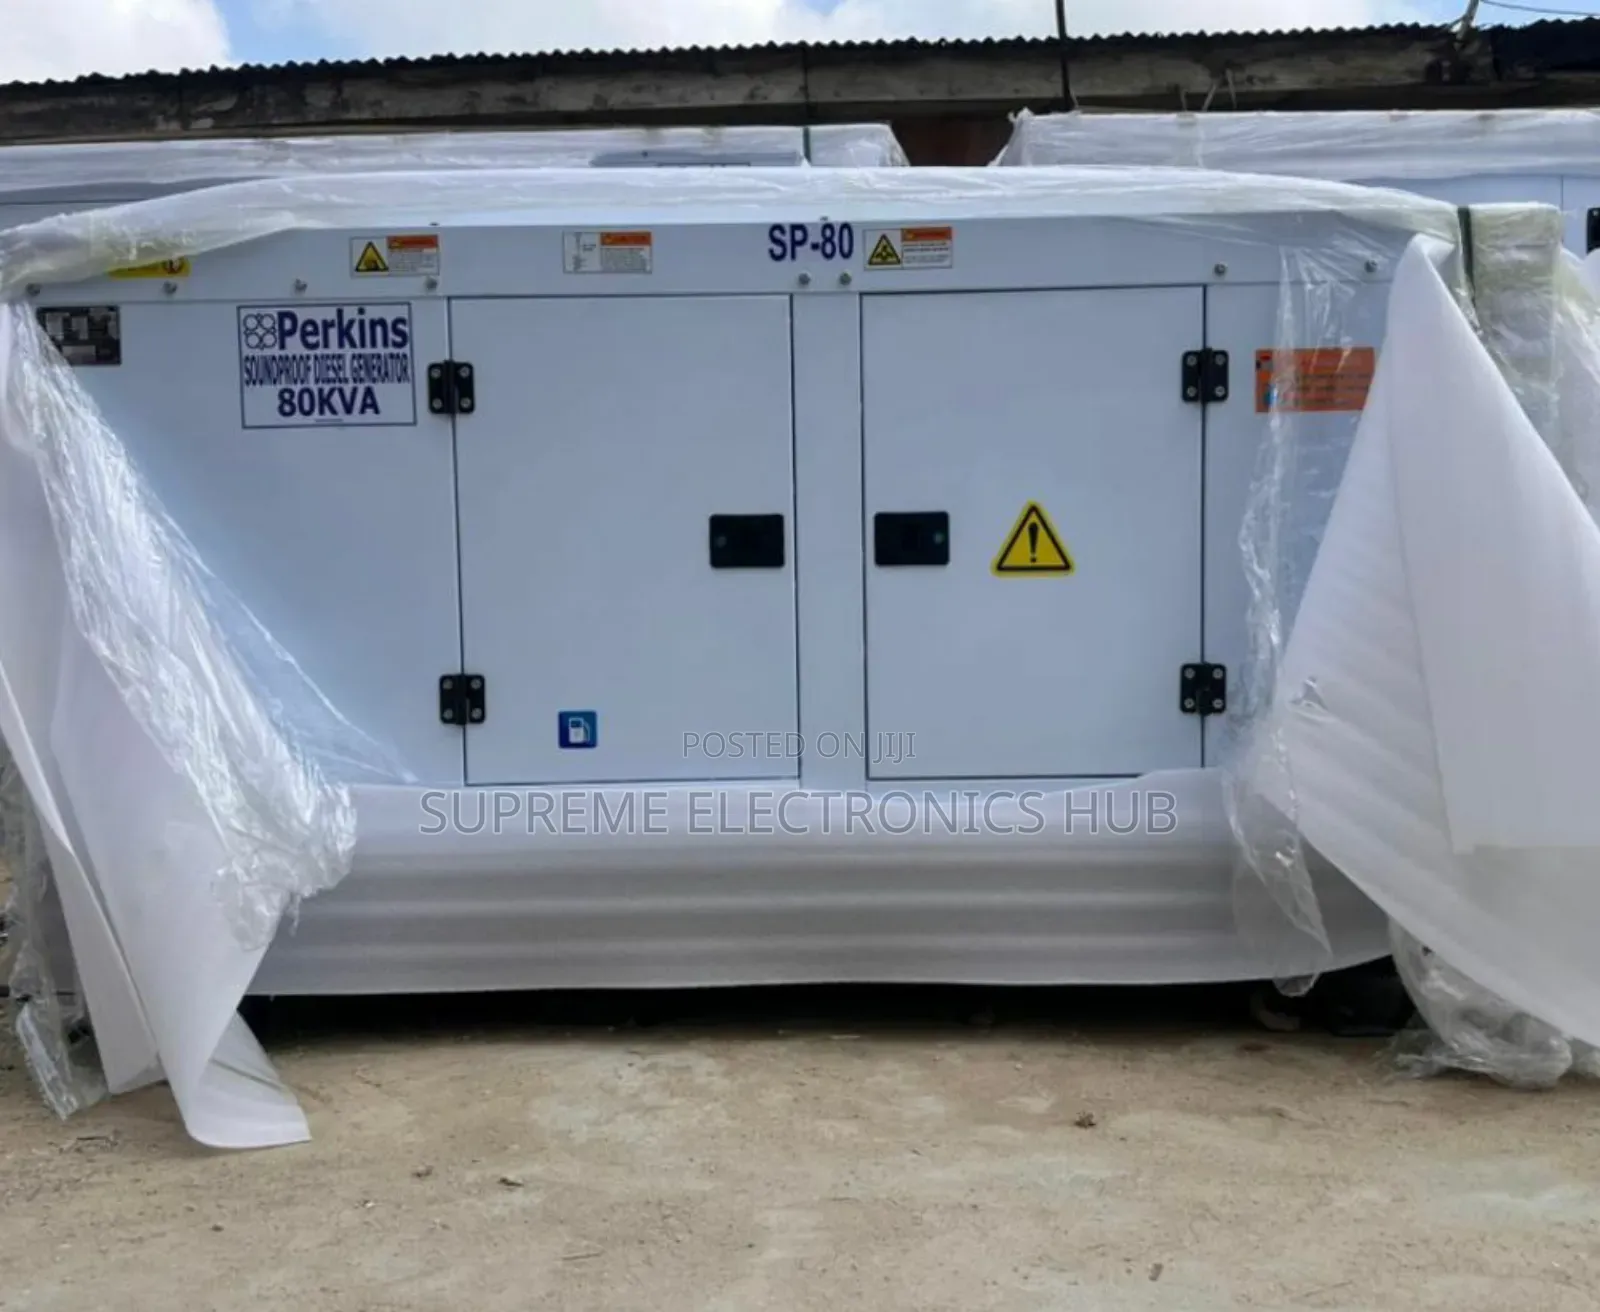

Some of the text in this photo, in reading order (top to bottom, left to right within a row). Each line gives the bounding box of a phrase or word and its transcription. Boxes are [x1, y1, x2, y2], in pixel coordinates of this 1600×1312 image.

[768, 222, 854, 262] SP-80
[277, 307, 409, 351] Perkins
[243, 352, 410, 386] SOUNDPROOF DIESEL GENERATOR
[277, 386, 380, 418] 80KVA
